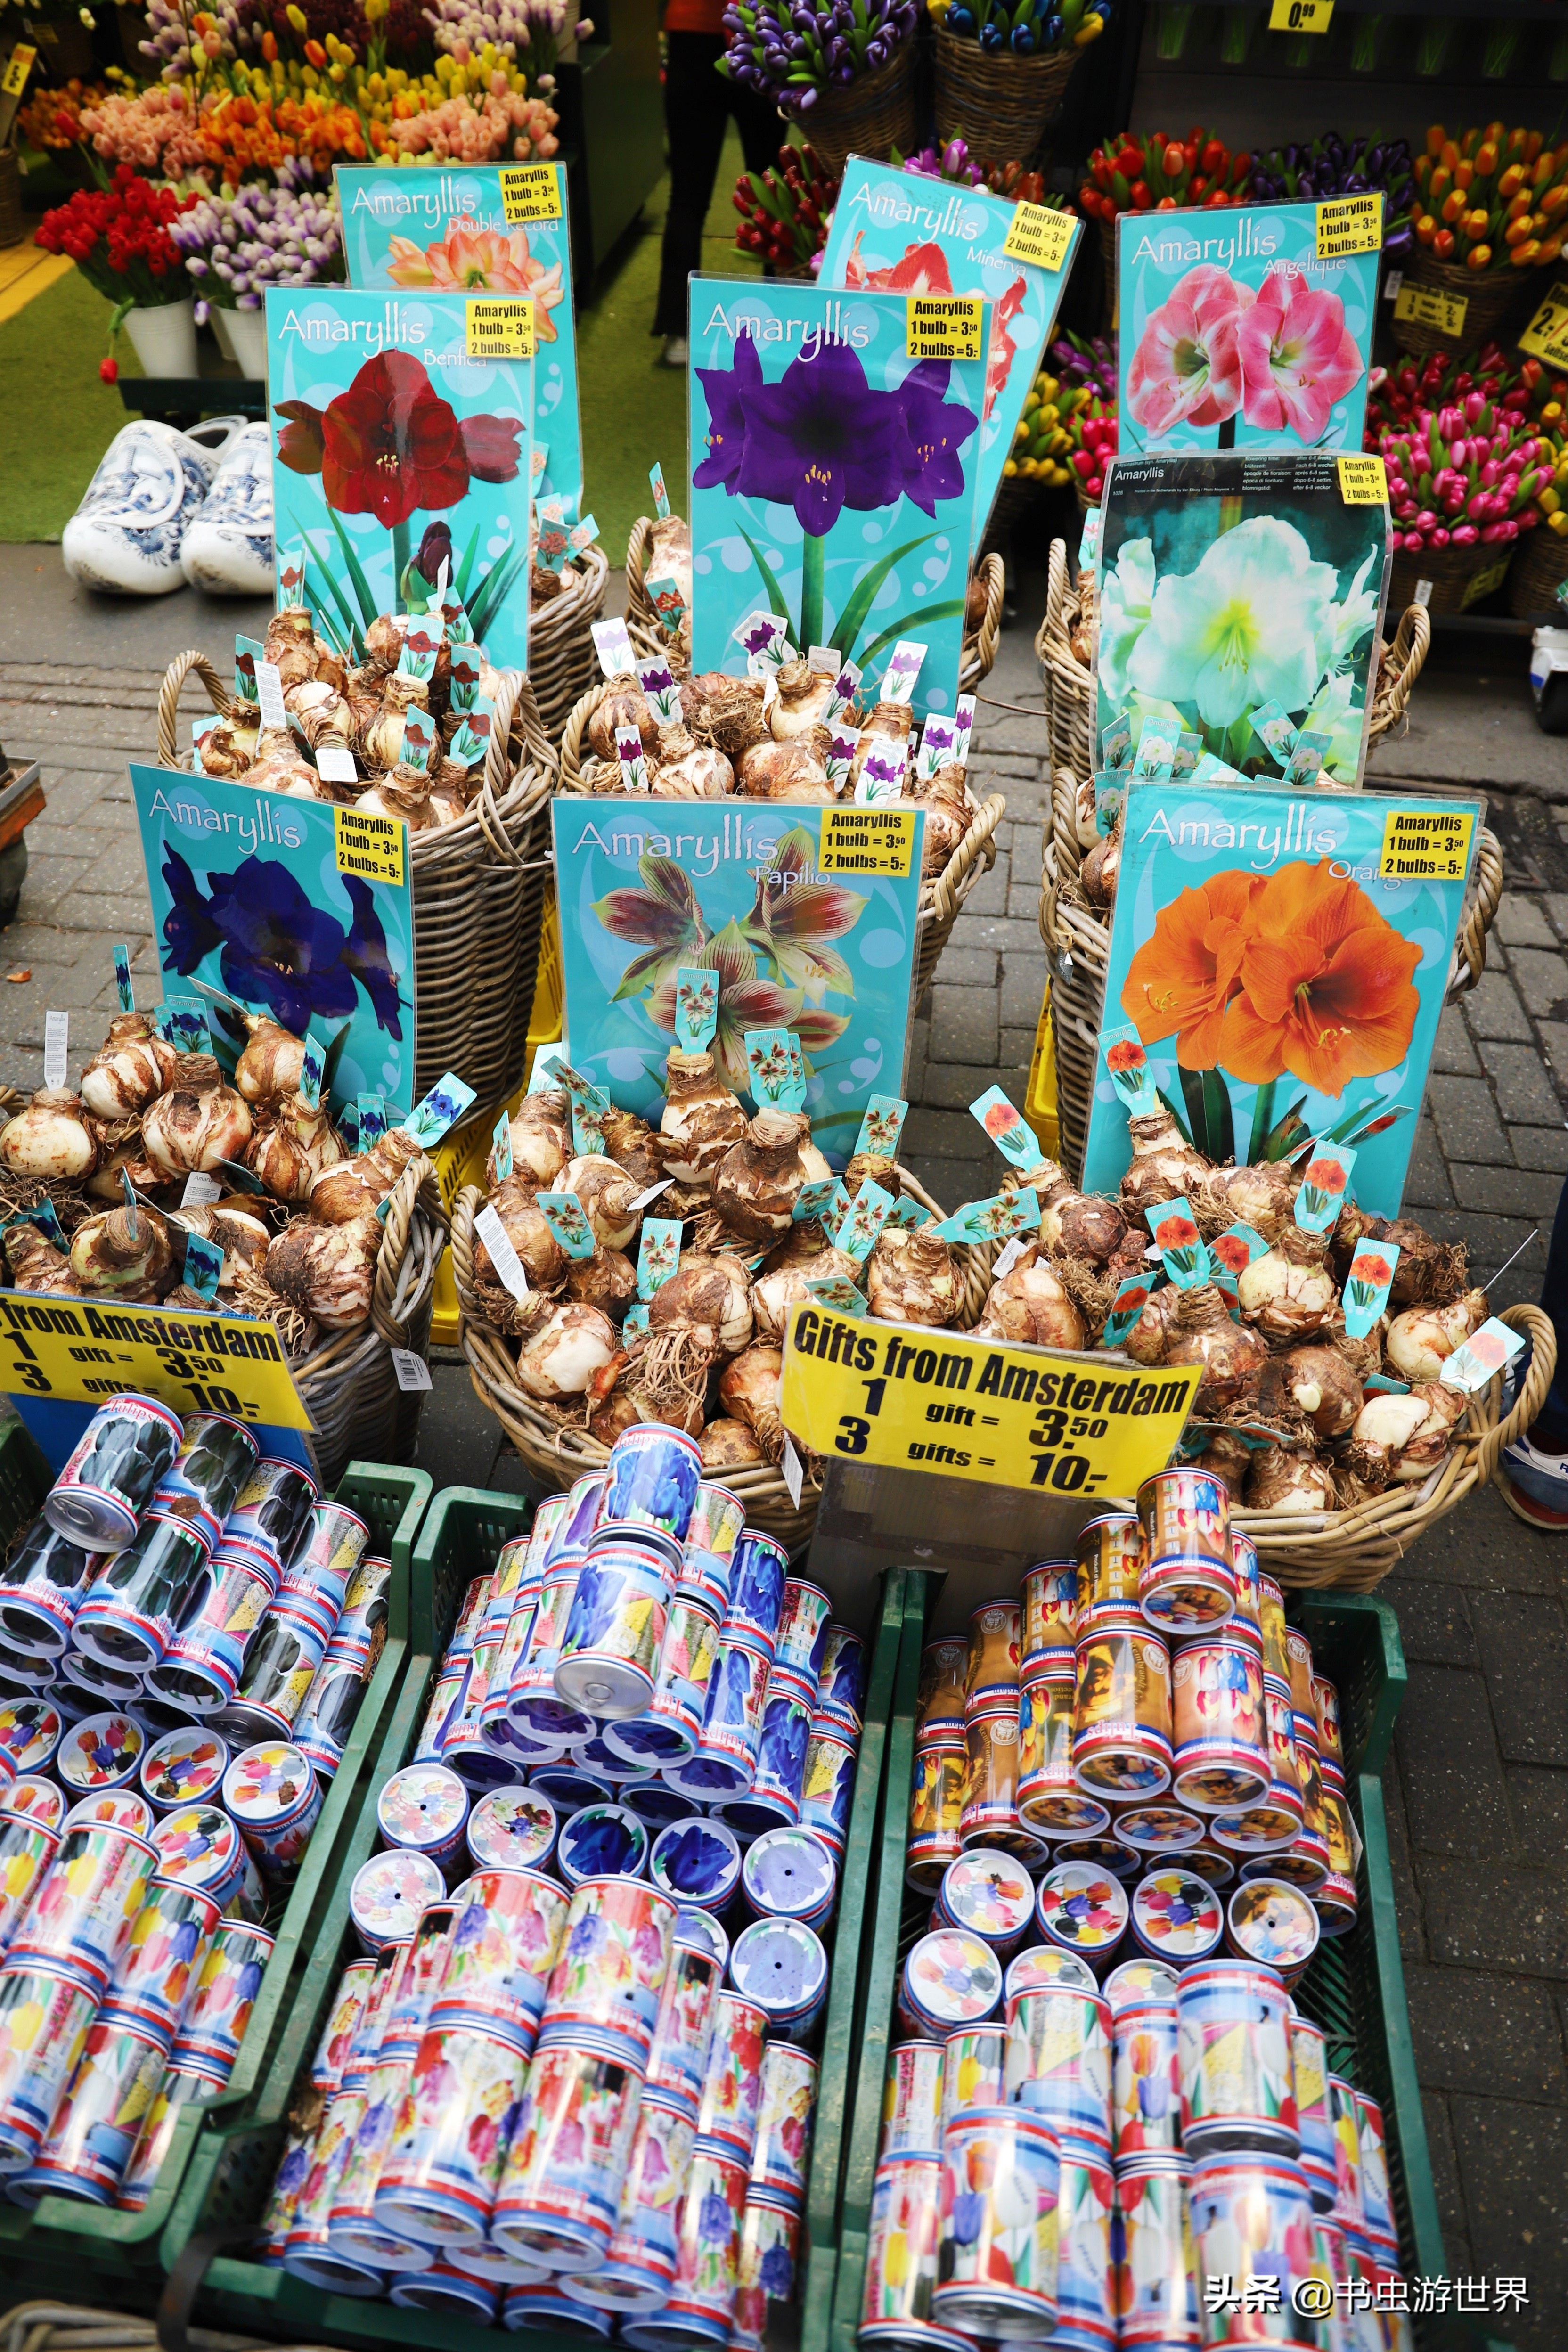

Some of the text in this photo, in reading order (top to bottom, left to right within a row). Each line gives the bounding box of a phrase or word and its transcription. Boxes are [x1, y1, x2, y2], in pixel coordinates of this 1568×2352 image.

[505, 169, 549, 185] Amaryllis
[351, 175, 477, 229] Amaryllis
[505, 191, 509, 201] 1
[511, 188, 531, 201] bulb
[506, 208, 513, 219] 2
[514, 205, 540, 218] bulbs
[849, 182, 979, 243] Amaryllis
[1021, 206, 1067, 228] Amaryllis
[1322, 200, 1373, 220] Amaryllis
[448, 212, 502, 232] Double
[1015, 221, 1020, 231] 1
[1020, 223, 1042, 237] bulb
[1319, 225, 1323, 237] 1
[1327, 221, 1350, 236] bulb
[1007, 237, 1015, 248] 2
[1015, 239, 1043, 256] bulbs
[1131, 217, 1277, 273] Amaryllis
[1319, 243, 1325, 255] 2
[1328, 239, 1357, 253] bulbs
[967, 245, 1027, 277] Minerva
[1262, 251, 1347, 280] Angelique
[475, 305, 526, 318] Amaryllis
[915, 301, 973, 316] Amaryllis
[278, 301, 425, 359] Amaryllis
[472, 323, 476, 335] 1
[479, 323, 503, 335] bulb
[703, 299, 870, 362] Amaryllis
[911, 321, 916, 334] 1
[920, 321, 947, 335] bulb
[472, 342, 477, 353] 2
[481, 342, 511, 353] bulbs
[910, 342, 917, 355] 2
[921, 342, 955, 356] bulbs
[1115, 467, 1164, 481] Amaryllis
[1345, 461, 1375, 471] Amaryllis
[1344, 475, 1348, 483] 1
[1349, 474, 1364, 483] bulb
[1347, 490, 1351, 498] 2
[1352, 489, 1370, 498] bulbs
[149, 788, 301, 855] Amaryllis
[342, 811, 393, 835] Amaryllis
[831, 814, 901, 828] Amaryllis
[1395, 816, 1462, 832] Amaryllis
[339, 831, 343, 844] 1
[346, 832, 370, 850] bulb
[826, 833, 833, 846] 1
[836, 833, 868, 847] bulb
[1138, 802, 1337, 870] Amaryllis
[1389, 837, 1395, 850] 1
[1398, 836, 1429, 851] bulb
[572, 813, 779, 878] Amaryllis
[339, 851, 345, 866] 2
[348, 854, 378, 873] bulbs
[824, 854, 833, 867] 2
[836, 854, 877, 868] bulbs
[1385, 858, 1394, 873] 2
[1396, 859, 1436, 873] bulbs
[755, 862, 831, 895] Papilio
[684, 972, 713, 980] Amaryllis
[172, 999, 200, 1009] Amaryllis
[750, 1032, 782, 1042] Amaryllis
[1104, 1027, 1132, 1040] Amaryllis
[1362, 1240, 1393, 1252] Amaryllis
[83, 1307, 281, 1362] Amsterdam
[4, 1331, 38, 1361] 1
[69, 1346, 115, 1364] gift
[794, 1309, 1190, 1416] Gifts from Amsterdam
[13, 1362, 52, 1391] 3
[82, 1377, 137, 1394] gifts
[108, 1398, 154, 1422] Tulips
[861, 1377, 887, 1416] 1
[925, 1402, 977, 1427] gift
[834, 1415, 871, 1455] 3
[907, 1440, 972, 1467] gifts
[276, 1611, 318, 1635] Amsterdam
